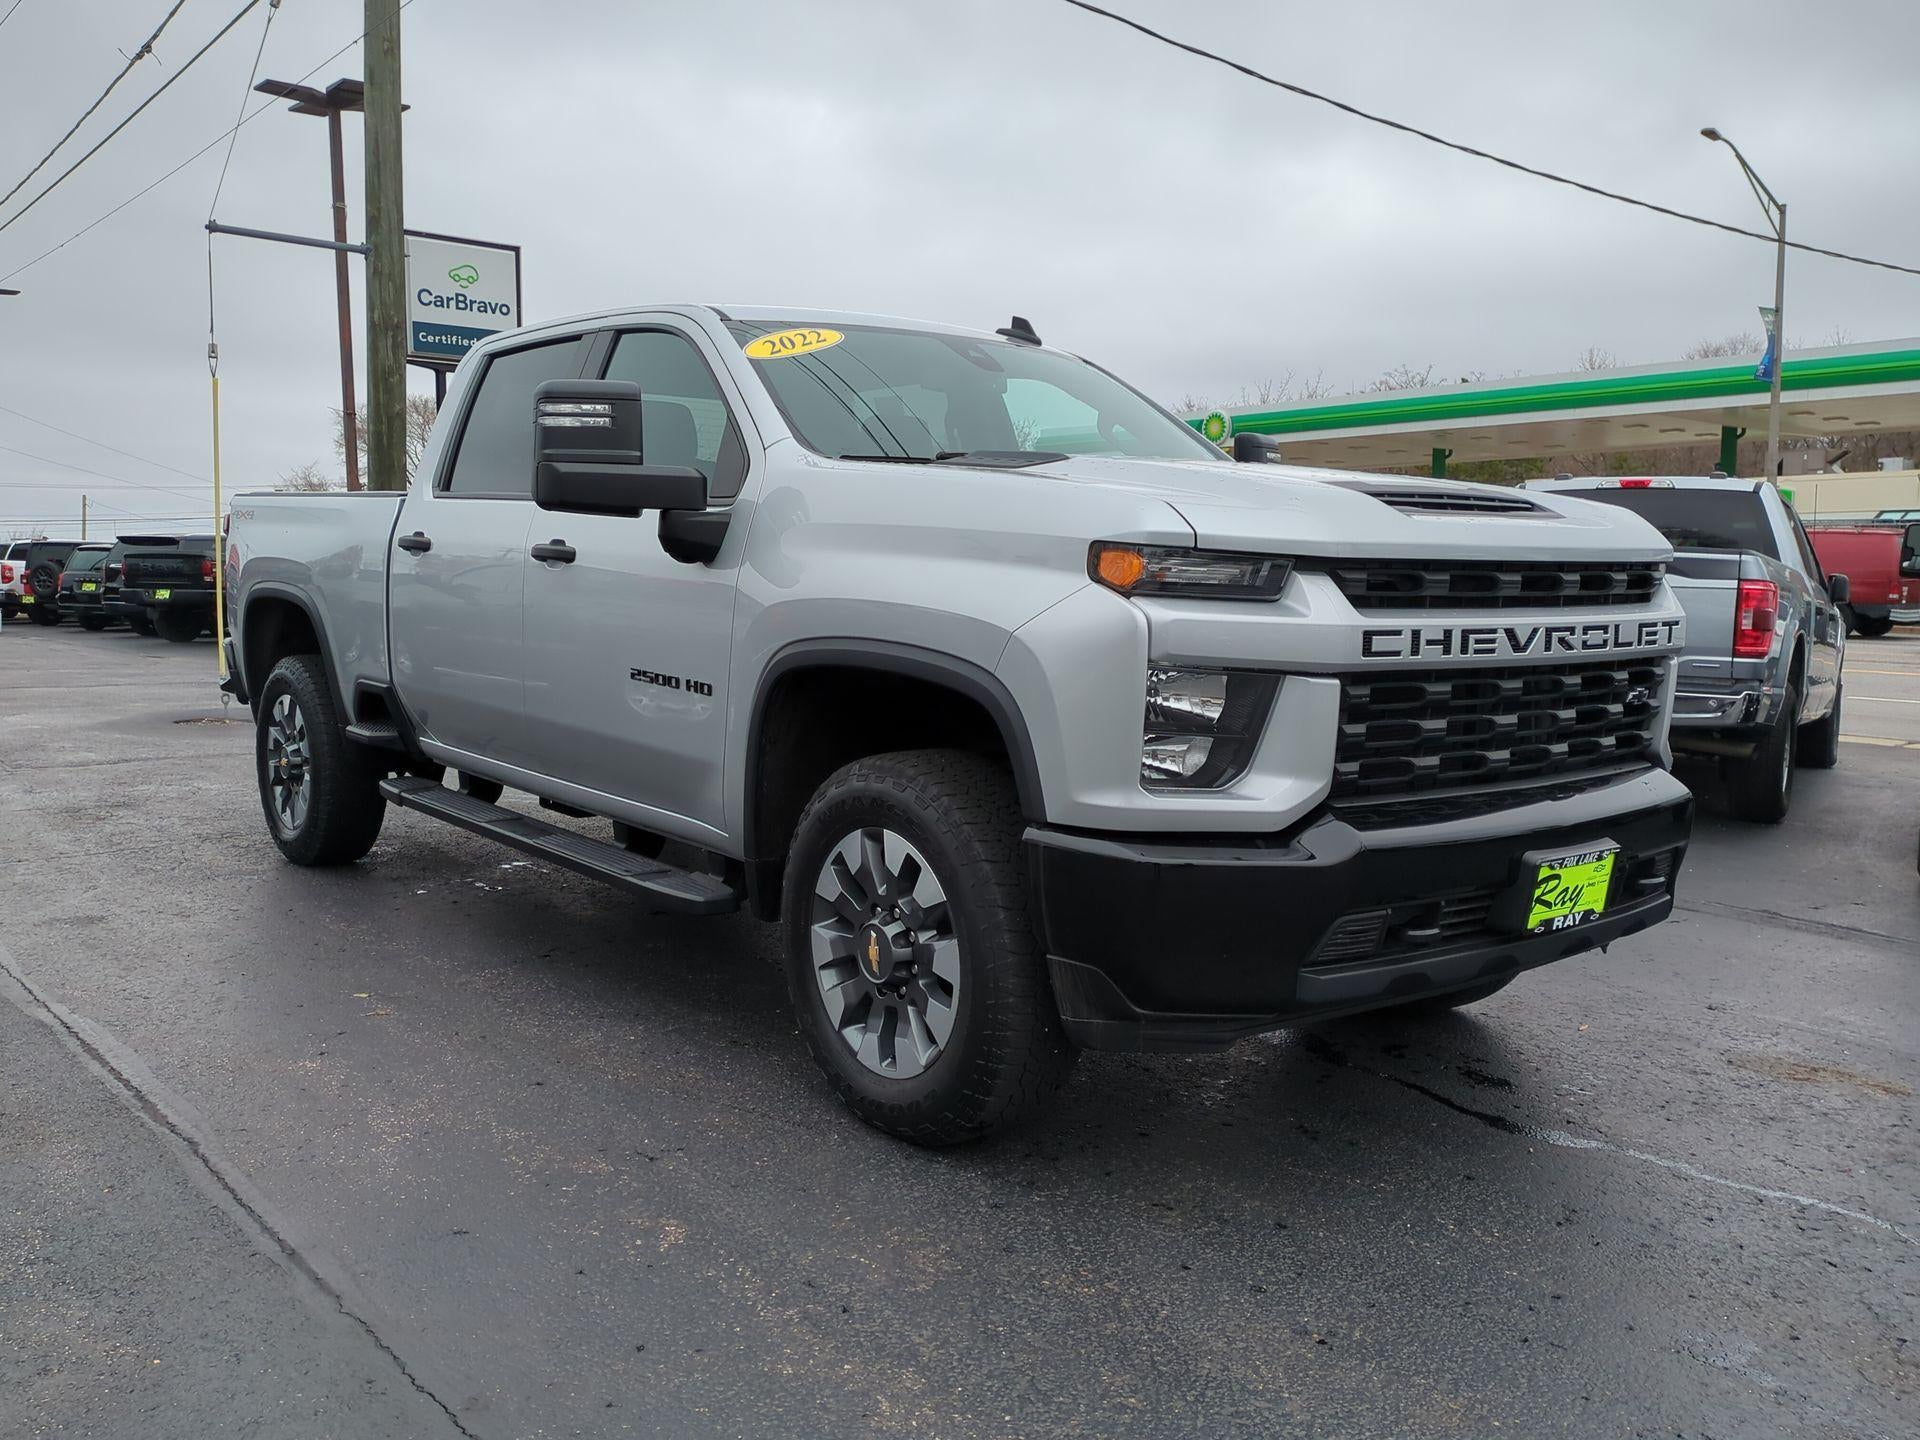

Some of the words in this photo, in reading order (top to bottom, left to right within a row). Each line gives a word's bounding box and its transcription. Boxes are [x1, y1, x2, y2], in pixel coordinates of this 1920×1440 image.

[417, 288, 511, 316] CarBravo
[418, 331, 477, 347] Certified
[762, 330, 827, 355] 2022
[1361, 619, 1681, 659] CHEVROLET
[630, 667, 680, 690] 2500
[685, 678, 713, 697] HD
[1562, 855, 1580, 869] FOX
[1579, 852, 1600, 866] LAKE
[1531, 873, 1585, 914] Ray
[1552, 911, 1585, 931] RAY
